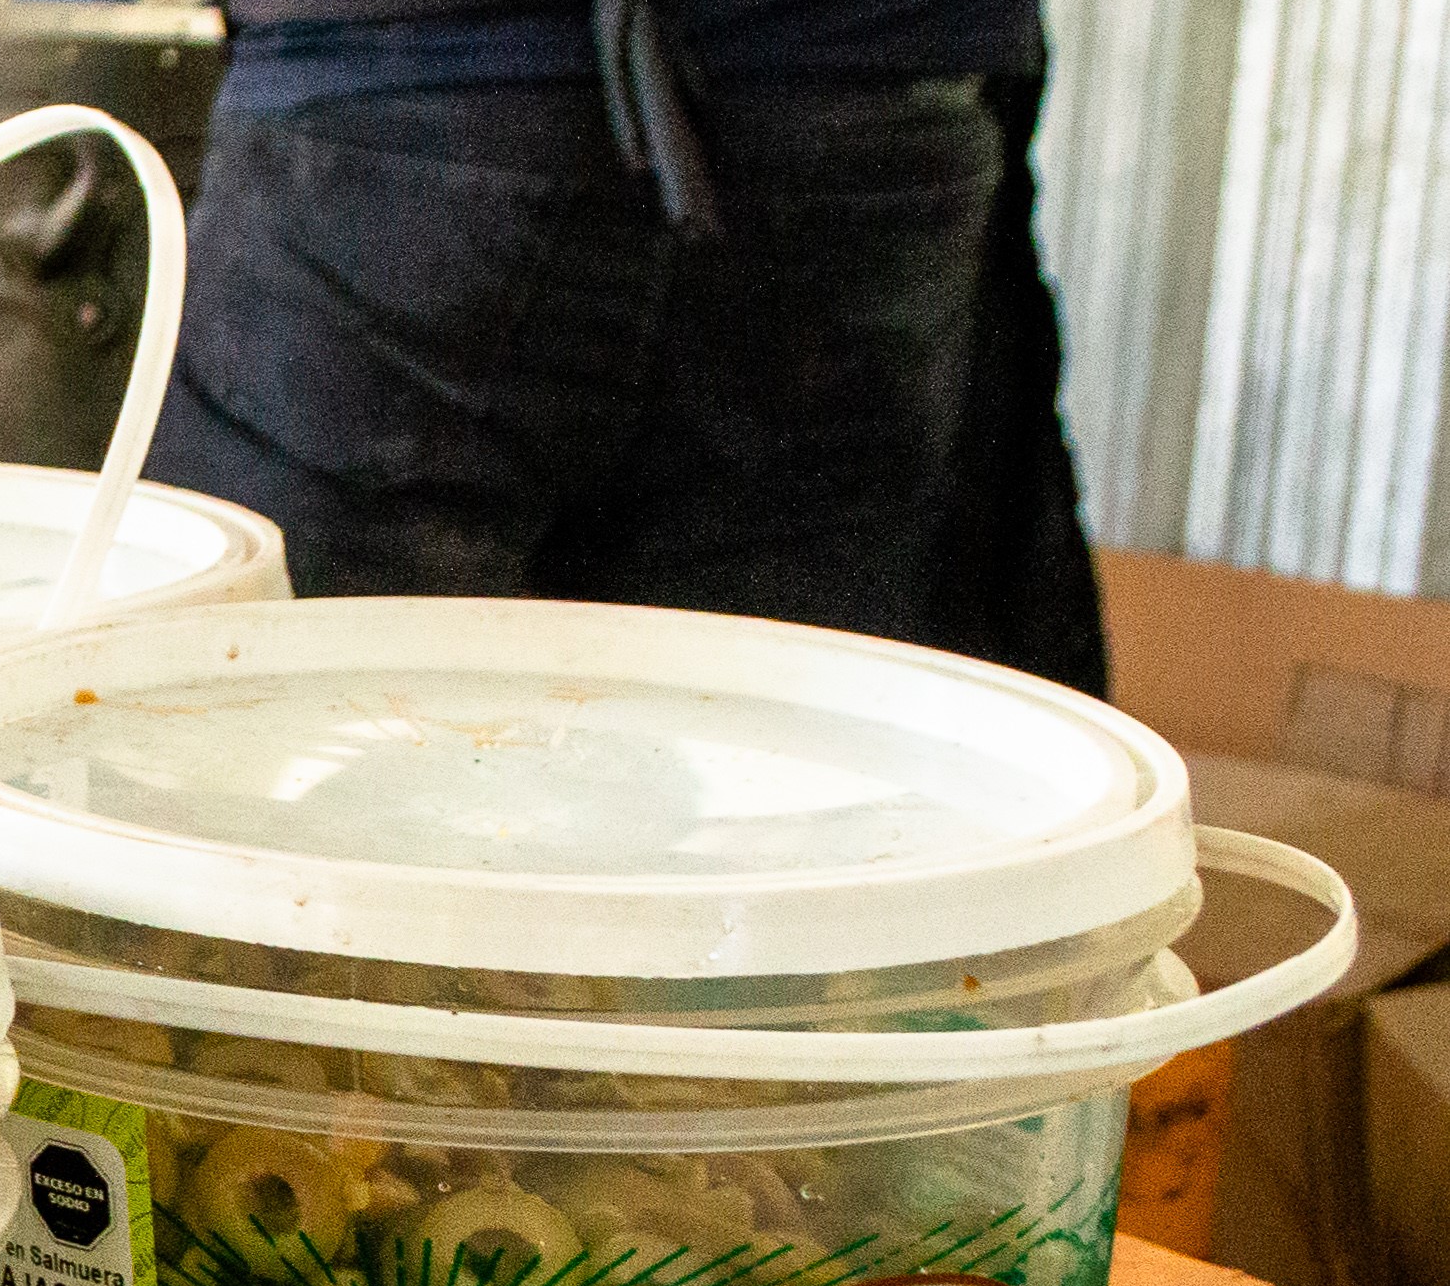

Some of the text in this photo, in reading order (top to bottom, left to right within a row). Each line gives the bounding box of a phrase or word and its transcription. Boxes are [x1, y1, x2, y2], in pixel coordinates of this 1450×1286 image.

[34, 1172, 104, 1201] EXCESO EN
[48, 1192, 90, 1213] SODIO
[6, 1241, 25, 1259] en
